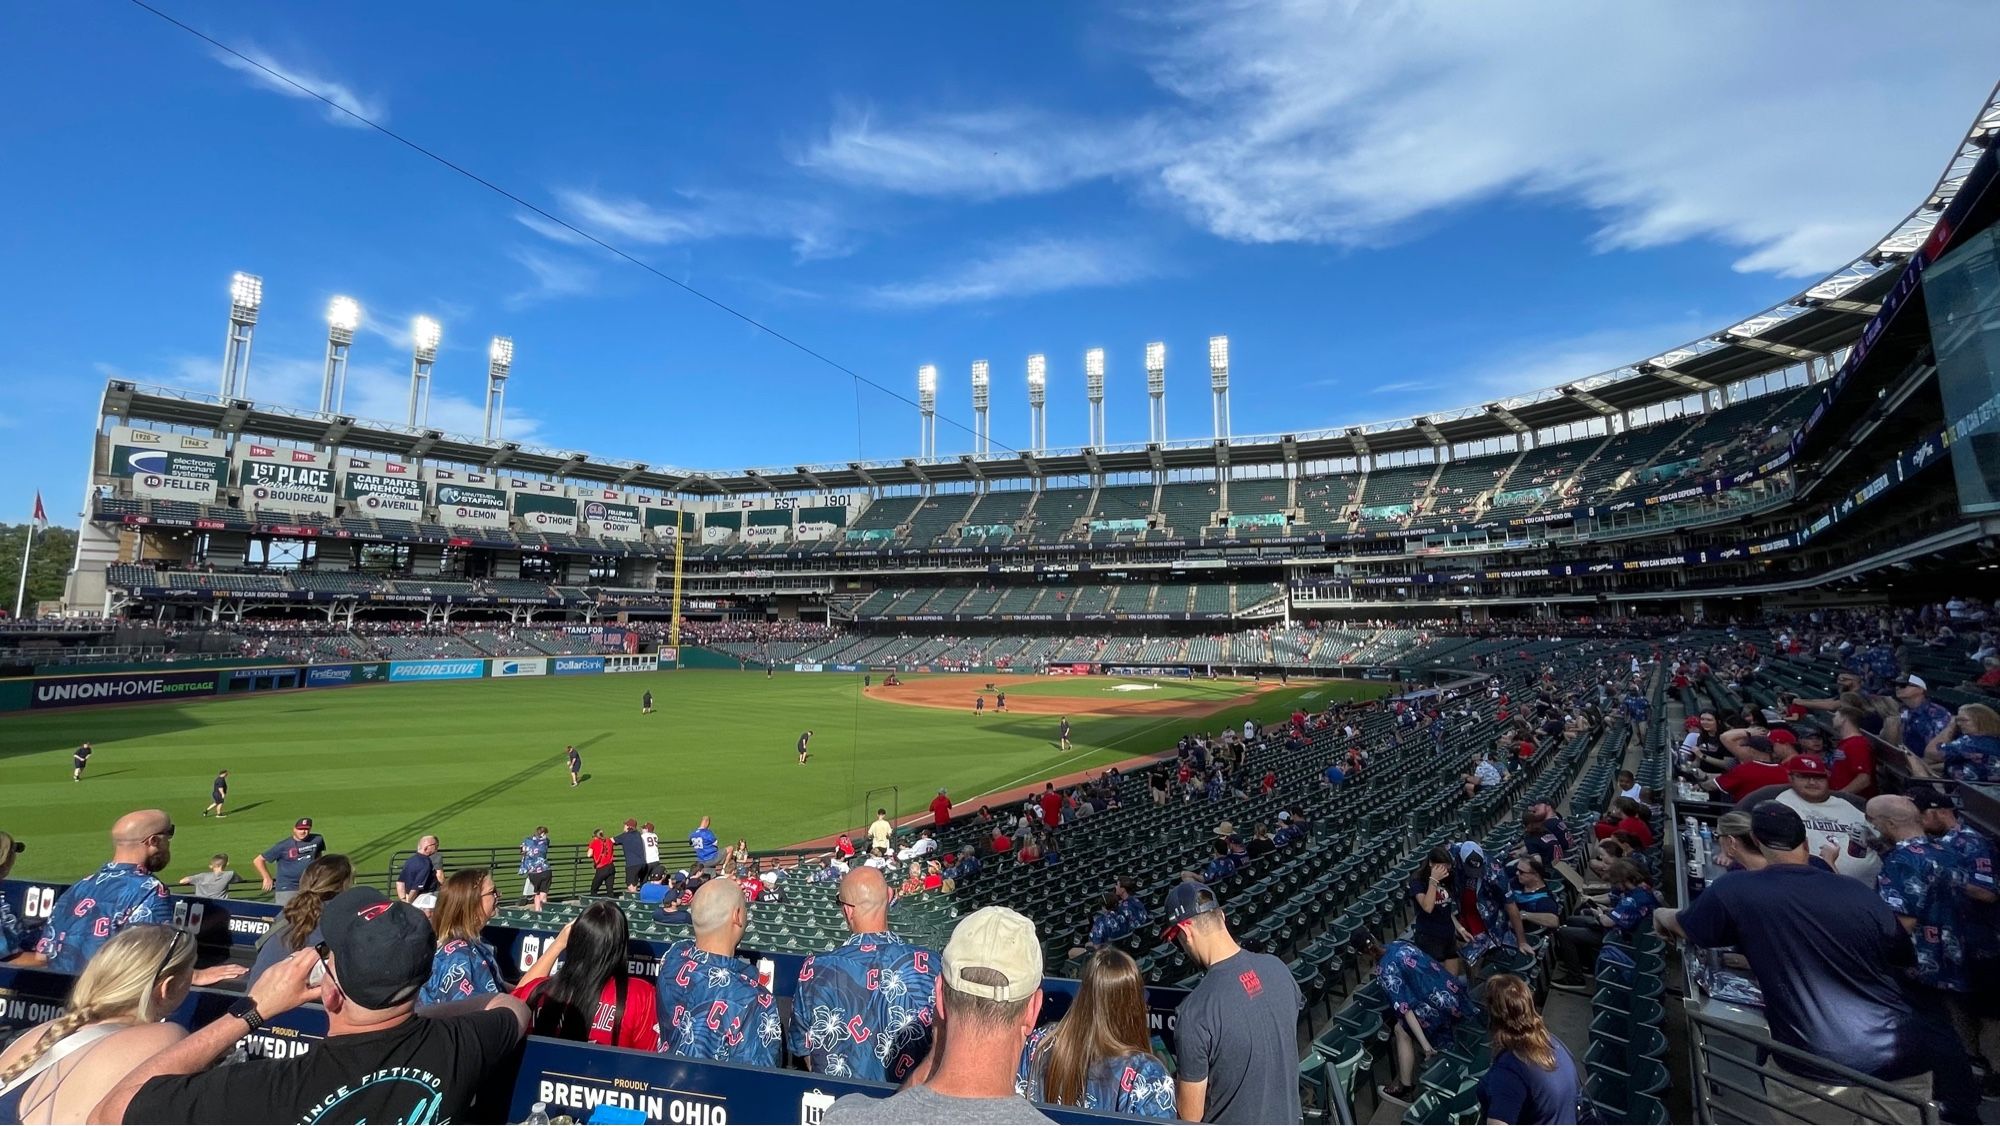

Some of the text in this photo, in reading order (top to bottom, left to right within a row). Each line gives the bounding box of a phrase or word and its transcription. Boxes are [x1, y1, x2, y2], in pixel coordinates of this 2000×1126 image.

[135, 433, 151, 441] 1920
[172, 464, 215, 475] merchant
[173, 458, 217, 468] electronic
[171, 471, 210, 479] systems
[251, 463, 329, 487] 1ST PLACE
[357, 475, 418, 488] CAR PARTS
[147, 476, 210, 492] 19 FELLER
[353, 481, 420, 496] WAREHOUSE
[270, 490, 328, 504] BOUDREAU
[461, 492, 496, 500] MINUTEMEN
[461, 497, 504, 507] STAFFING
[774, 495, 851, 509] EST. 1901
[1645, 496, 1659, 505] TASTE
[1678, 489, 1695, 498] DEPEND
[381, 501, 419, 512] AVERILL
[608, 509, 625, 517] FOLLOW
[469, 511, 496, 520] LEMON
[549, 517, 572, 526] THOME
[612, 524, 629, 532] DOBY
[1624, 561, 1639, 569] TASTE
[1640, 560, 1649, 568] YOU
[1650, 559, 1660, 567] CAN
[1660, 557, 1677, 566] DEPEND
[588, 626, 604, 635] FOR
[310, 668, 352, 680] FirstEnergy
[393, 662, 478, 676] PROGRESSIVE
[163, 681, 214, 692] MORTGAGE
[74, 898, 96, 917] C
[94, 917, 109, 937] C
[229, 919, 270, 935] BREWED
[1924, 926, 1939, 943] C
[524, 942, 538, 953] Lite
[798, 954, 815, 982] C
[914, 951, 929, 973] C
[647, 963, 660, 977] IN
[675, 960, 698, 986] C
[866, 968, 879, 990] C
[459, 978, 474, 996] C
[8, 1000, 25, 1020] IN
[672, 1005, 684, 1027] C
[706, 1000, 728, 1030] C
[918, 1006, 933, 1028] C
[847, 1014, 871, 1044] C
[1146, 1013, 1163, 1030] IN
[271, 1026, 300, 1038] PROUDLY
[236, 1034, 310, 1060] EWED IN
[894, 1053, 915, 1078] C
[614, 1078, 649, 1091] PROUDLY
[1121, 1066, 1137, 1092] C
[297, 1085, 350, 1125] INCE
[540, 1080, 727, 1125] BREWED IN OHIO
[804, 1105, 825, 1125] Lit
